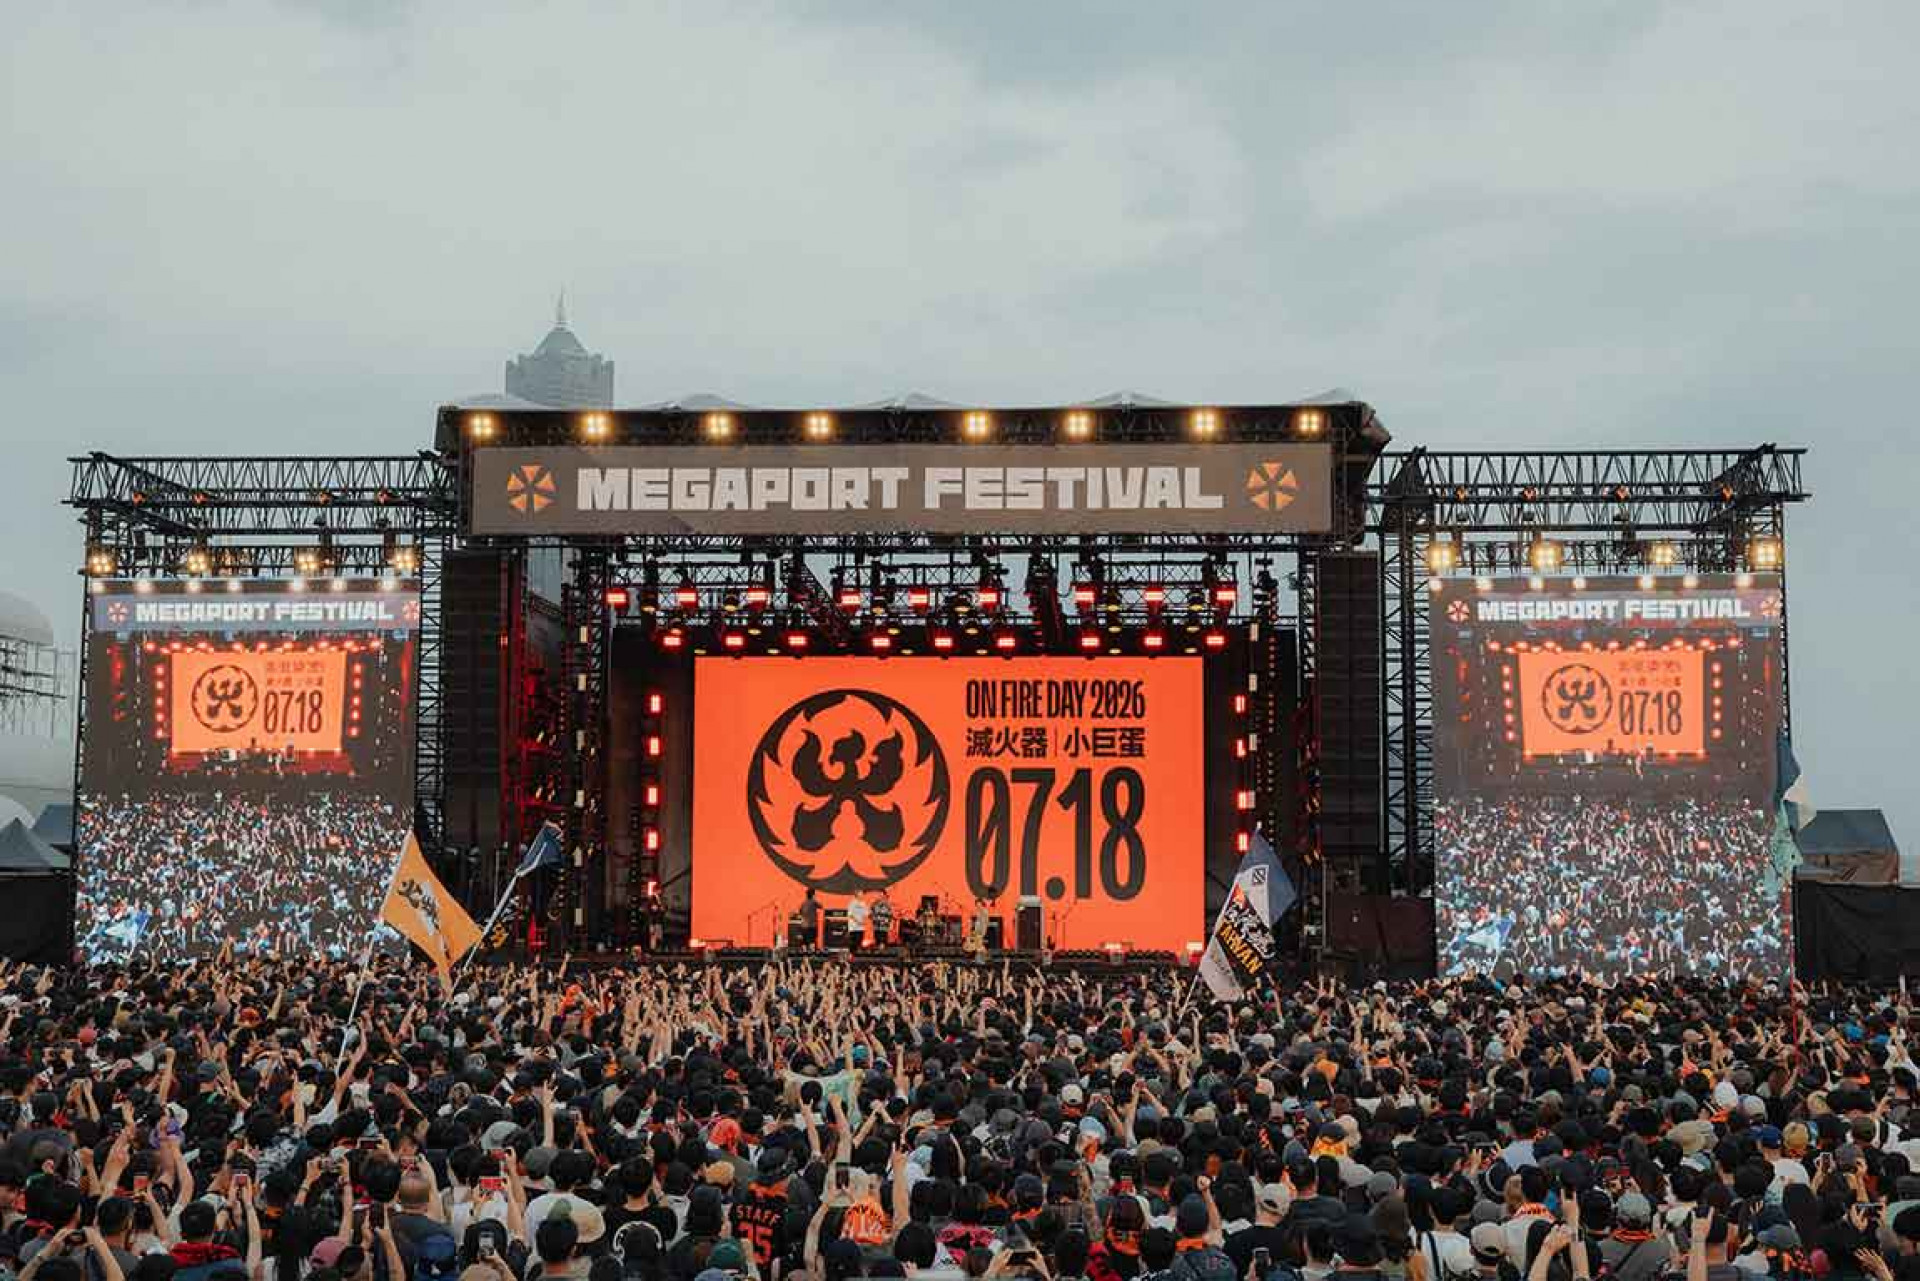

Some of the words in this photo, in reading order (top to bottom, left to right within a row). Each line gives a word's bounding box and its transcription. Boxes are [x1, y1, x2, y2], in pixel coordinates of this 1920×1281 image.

[576, 466, 908, 512] MEGAPORT
[923, 466, 1224, 510] FESTIVAL
[135, 602, 270, 622] MEGAPORT
[275, 601, 394, 621] FESTIVAL
[1477, 600, 1618, 620] MEGAPORT
[1625, 599, 1750, 619] FESTIVAL
[263, 690, 323, 734] 07.18
[966, 680, 996, 718] ON
[1001, 680, 1042, 718] FIRE
[1047, 680, 1086, 718] DAY
[1090, 680, 1146, 718] 2026
[1618, 690, 1683, 736] 07.18
[1064, 727, 1146, 758] 小巨蛋
[965, 766, 1147, 900] 07.18
